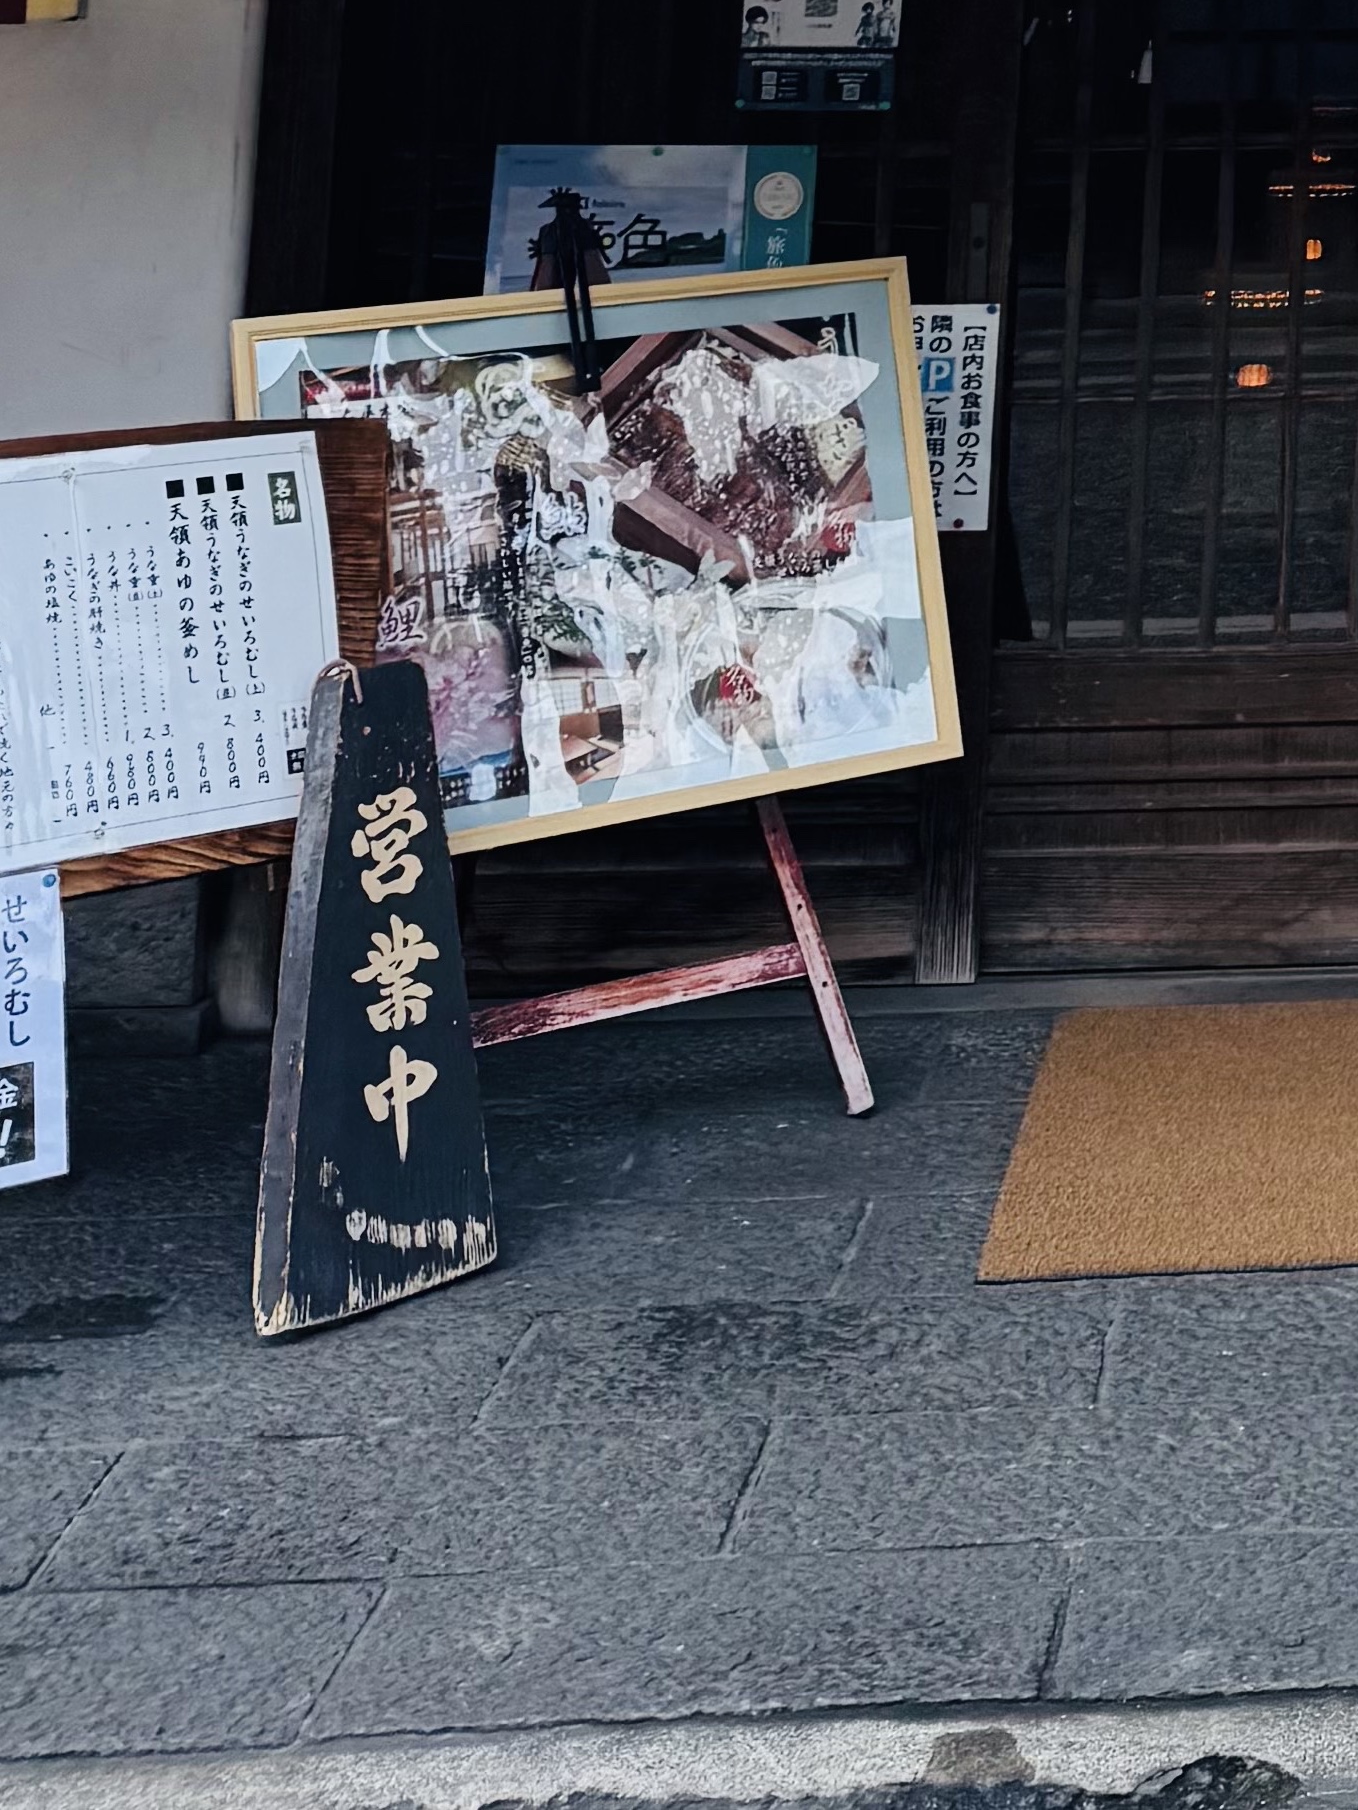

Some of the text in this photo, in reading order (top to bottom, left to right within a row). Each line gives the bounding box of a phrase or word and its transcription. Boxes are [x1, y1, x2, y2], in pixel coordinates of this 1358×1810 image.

[953, 324, 988, 497] 【店内お食事の方へ】
[273, 477, 297, 521] 名物
[63, 556, 78, 602] こいこく
[168, 502, 200, 684] 天領あゆの釜めし
[377, 596, 425, 648] 鯉
[1, 894, 31, 1047] せいろむし
[351, 786, 440, 1162] 営業中
